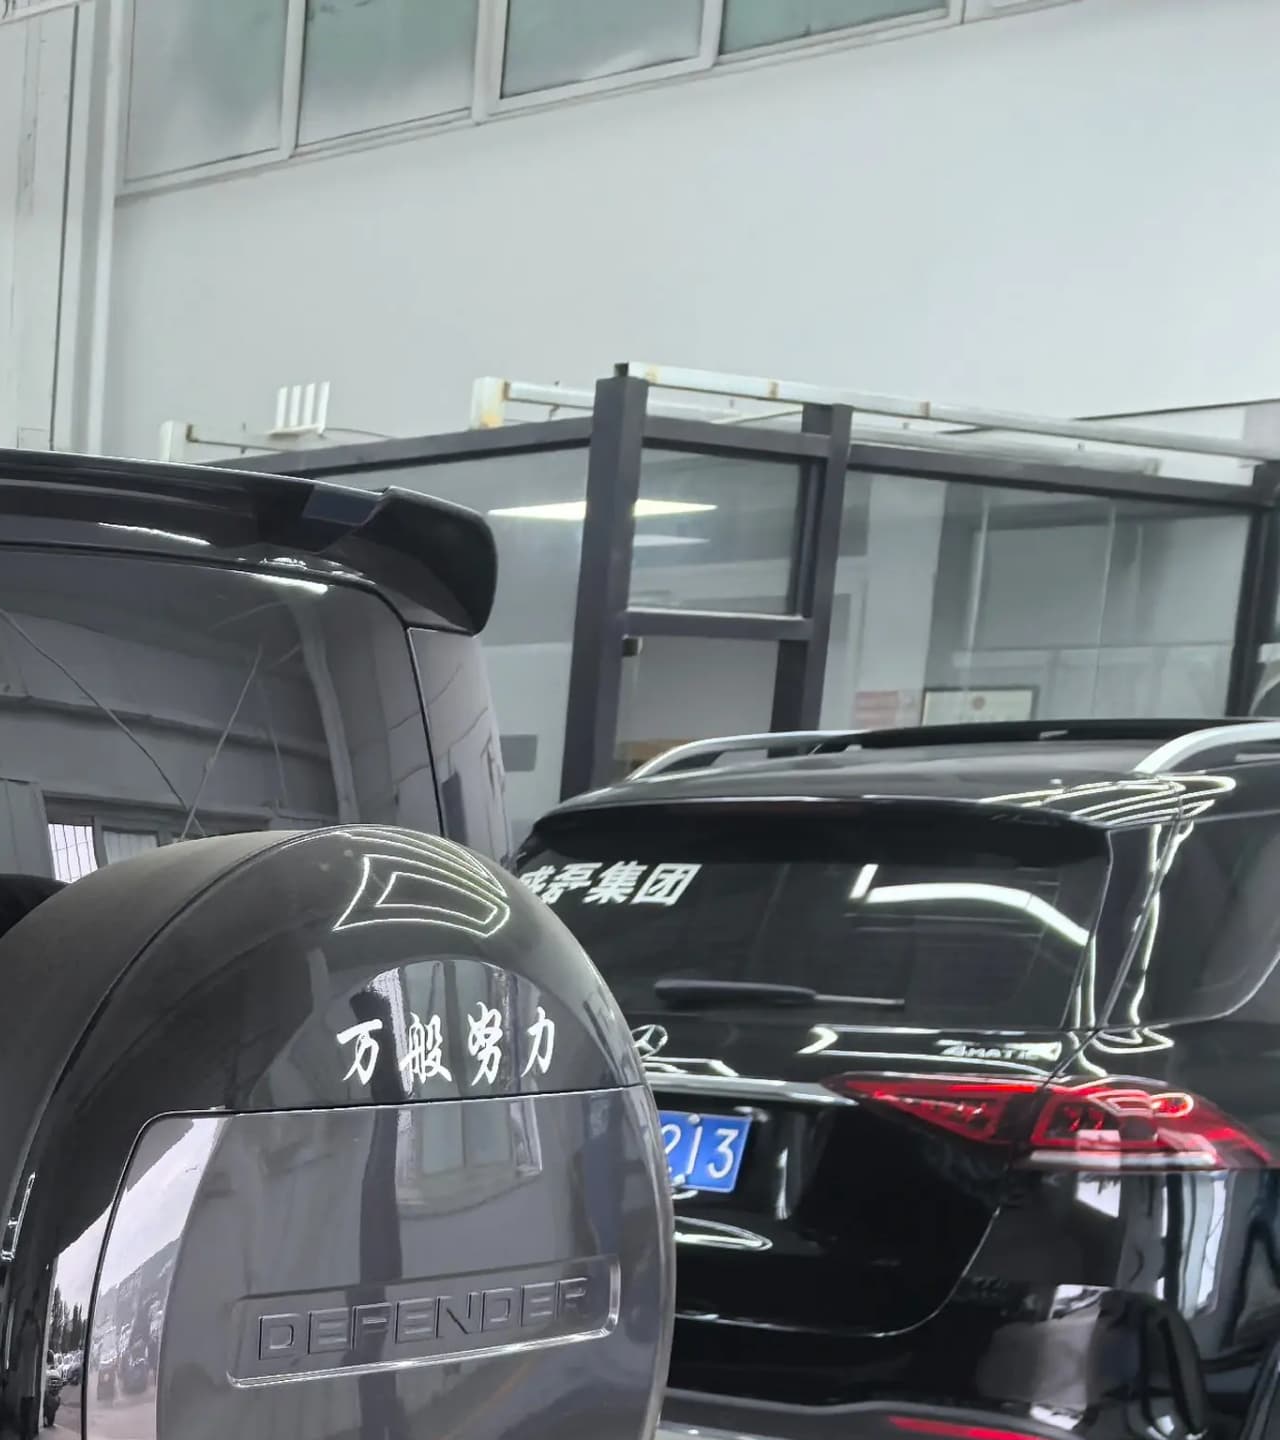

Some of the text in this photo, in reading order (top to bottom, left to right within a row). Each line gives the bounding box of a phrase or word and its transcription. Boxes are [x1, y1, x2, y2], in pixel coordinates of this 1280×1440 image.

[336, 1001, 555, 1086] 万般努力
[258, 1277, 588, 1361] DEFENDER
